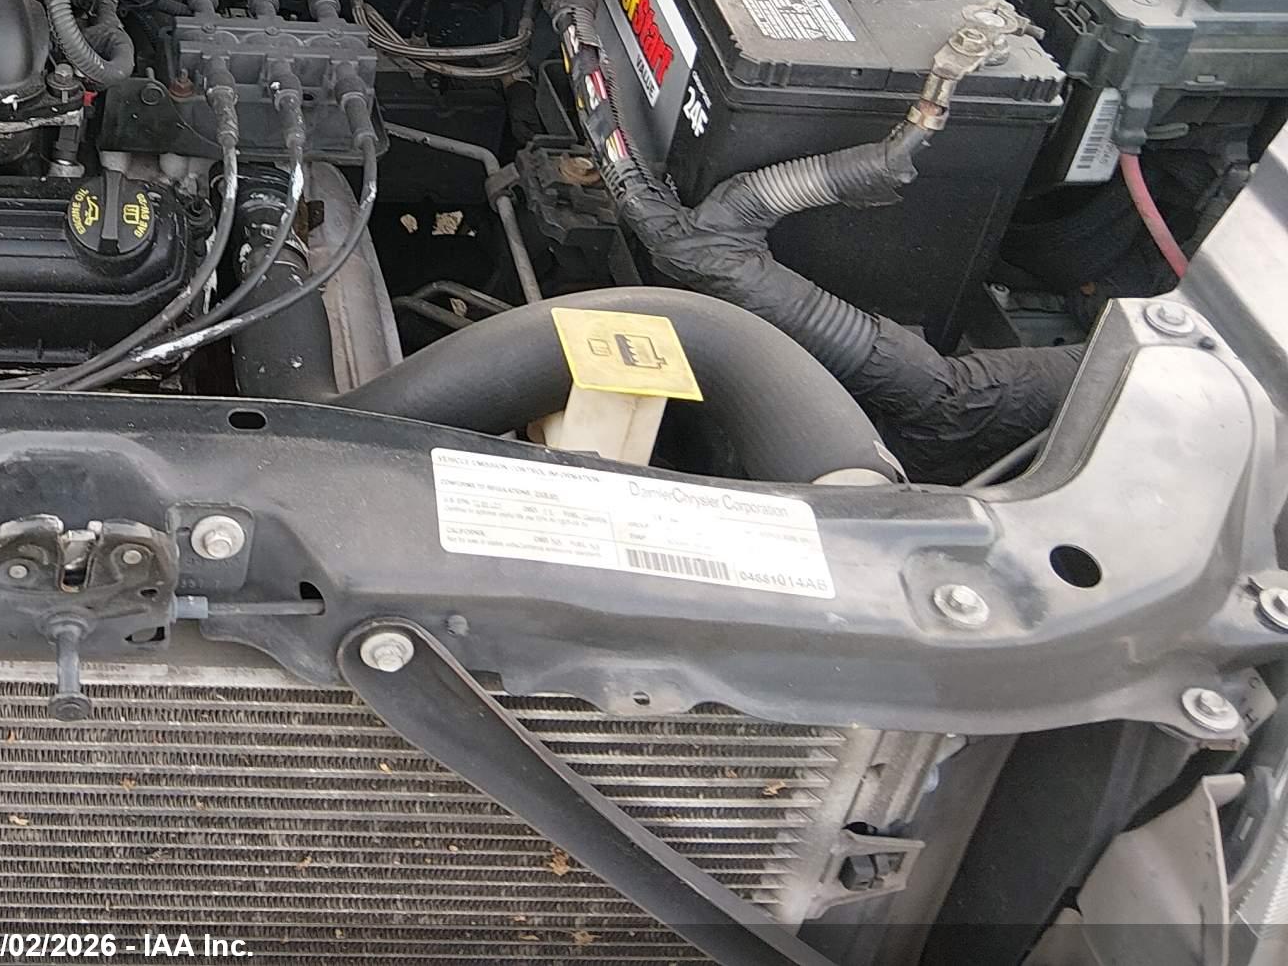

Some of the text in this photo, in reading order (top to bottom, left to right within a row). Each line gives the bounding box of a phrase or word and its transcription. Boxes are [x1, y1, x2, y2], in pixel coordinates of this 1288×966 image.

[635, 52, 658, 100] VALUE
[74, 187, 90, 202] OIL
[722, 494, 789, 518] Corporation
